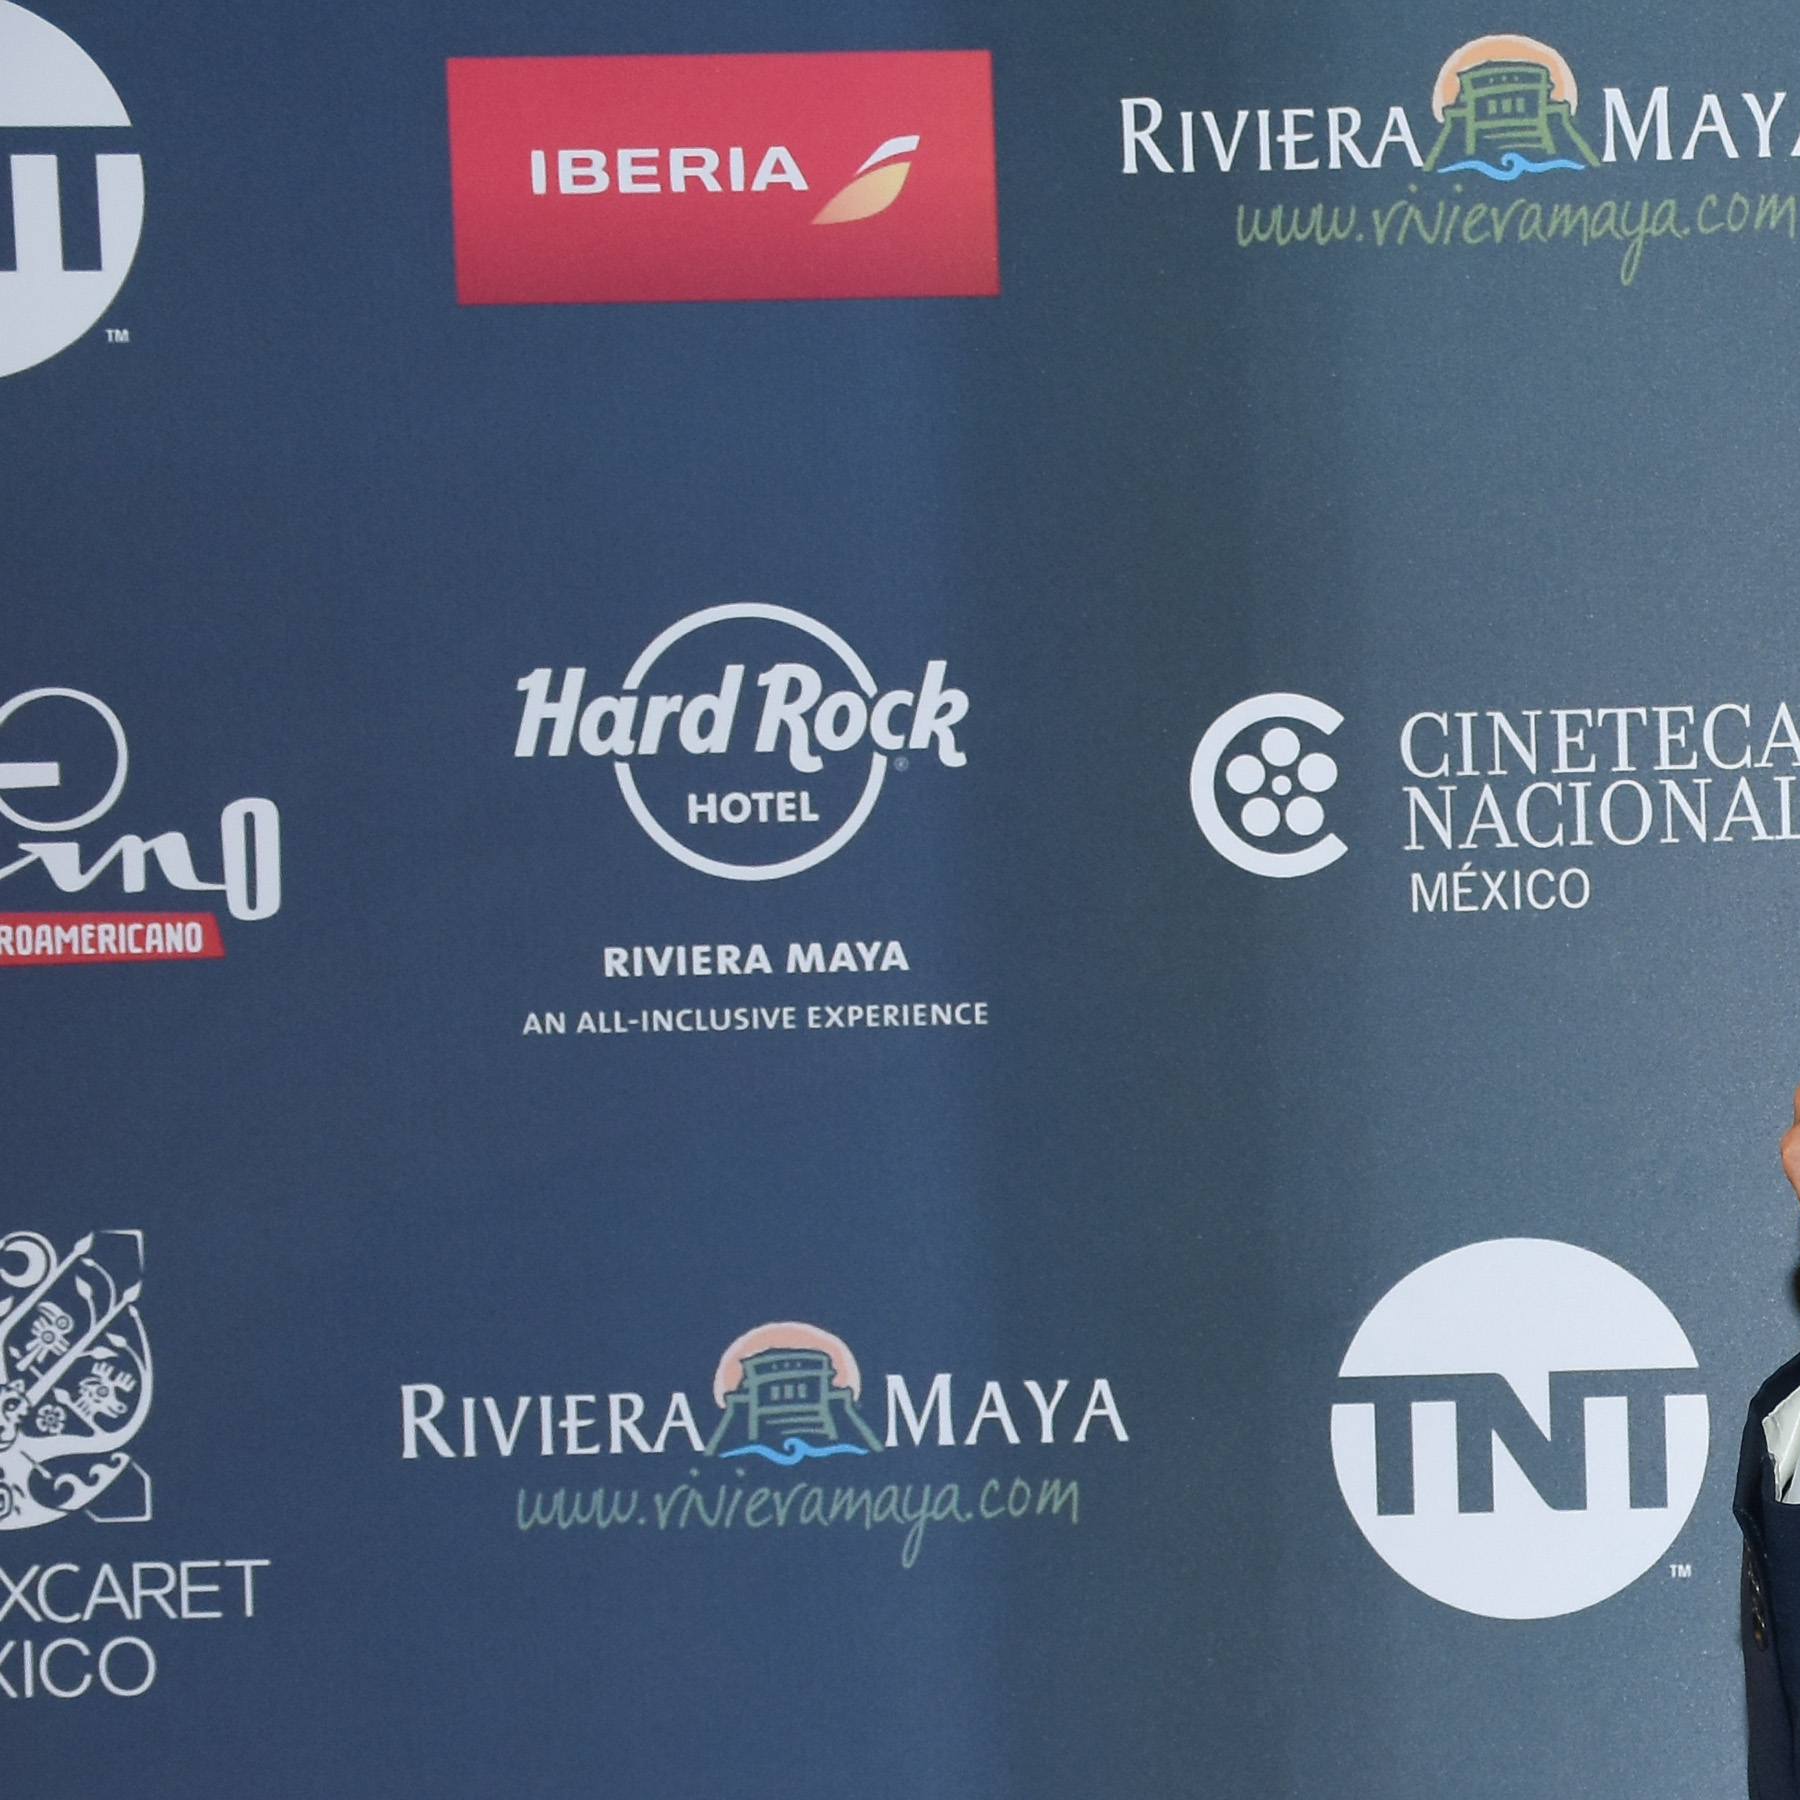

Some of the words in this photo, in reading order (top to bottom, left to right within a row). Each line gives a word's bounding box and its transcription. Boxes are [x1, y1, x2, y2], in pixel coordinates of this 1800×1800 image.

[1121, 97, 1425, 173] RIVIERA
[531, 146, 808, 194] IBERIA
[1236, 185, 1797, 285] www.rivieramaya.com
[515, 664, 744, 757] Hard
[755, 660, 969, 772] Rock
[688, 791, 819, 823] HOTEL
[1412, 862, 1590, 912] MÉXICO
[0, 921, 204, 955] ROAMERICANO
[605, 944, 772, 977] RIVIERA
[787, 941, 908, 972] MAYA
[523, 1012, 565, 1034] AN
[577, 1007, 795, 1033] ALL-INCLUSIVE
[808, 1003, 987, 1028] EXPERIENCE
[401, 1384, 706, 1458] RIVIERA
[885, 1373, 1128, 1446] MAYA
[1333, 1368, 1709, 1517] TNT
[516, 1467, 1081, 1569] www.rivieramaya.com
[0, 1636, 156, 1698] ICO
